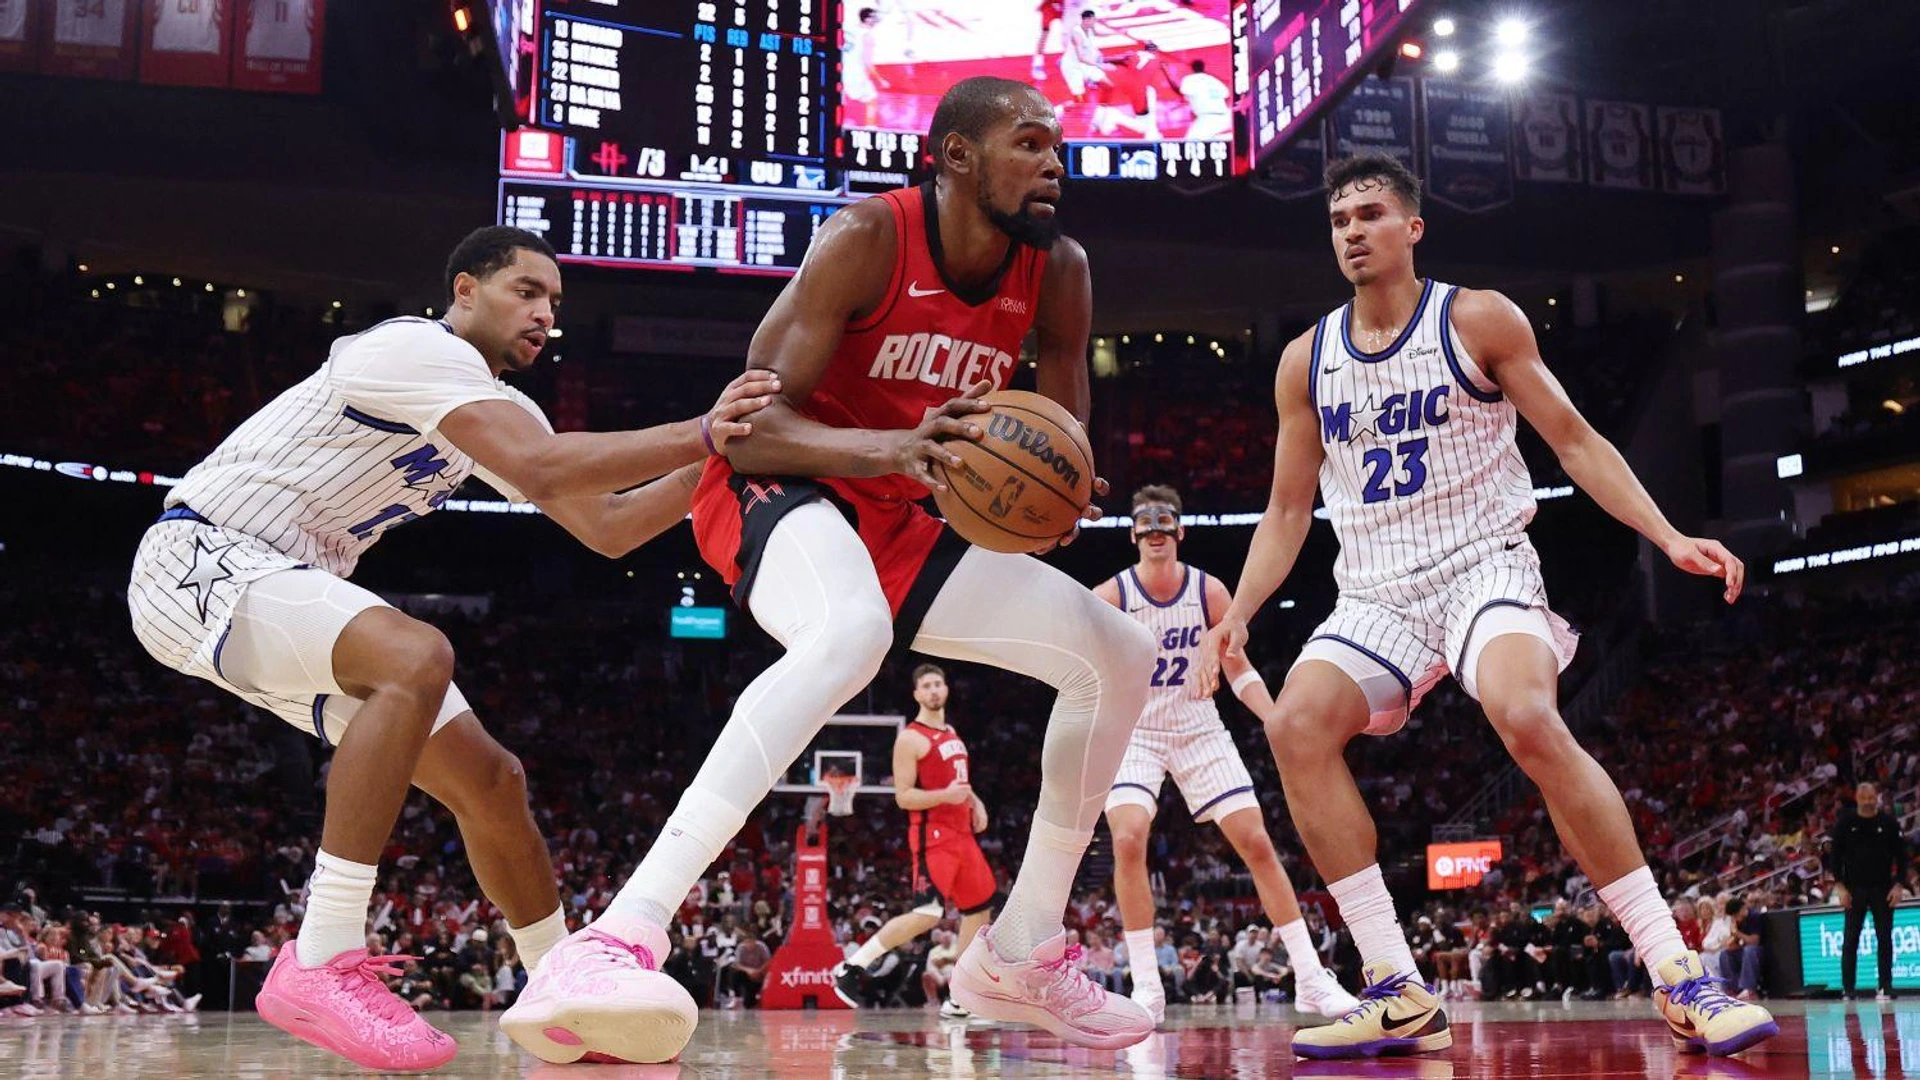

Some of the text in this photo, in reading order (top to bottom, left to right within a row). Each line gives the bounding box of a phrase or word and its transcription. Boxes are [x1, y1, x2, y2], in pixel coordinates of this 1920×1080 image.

[868, 332, 1013, 391] ROCKES
[987, 412, 1080, 490] Wilson
[1362, 437, 1429, 504] 23
[1150, 656, 1189, 687] 22
[1455, 856, 1492, 873] PNC
